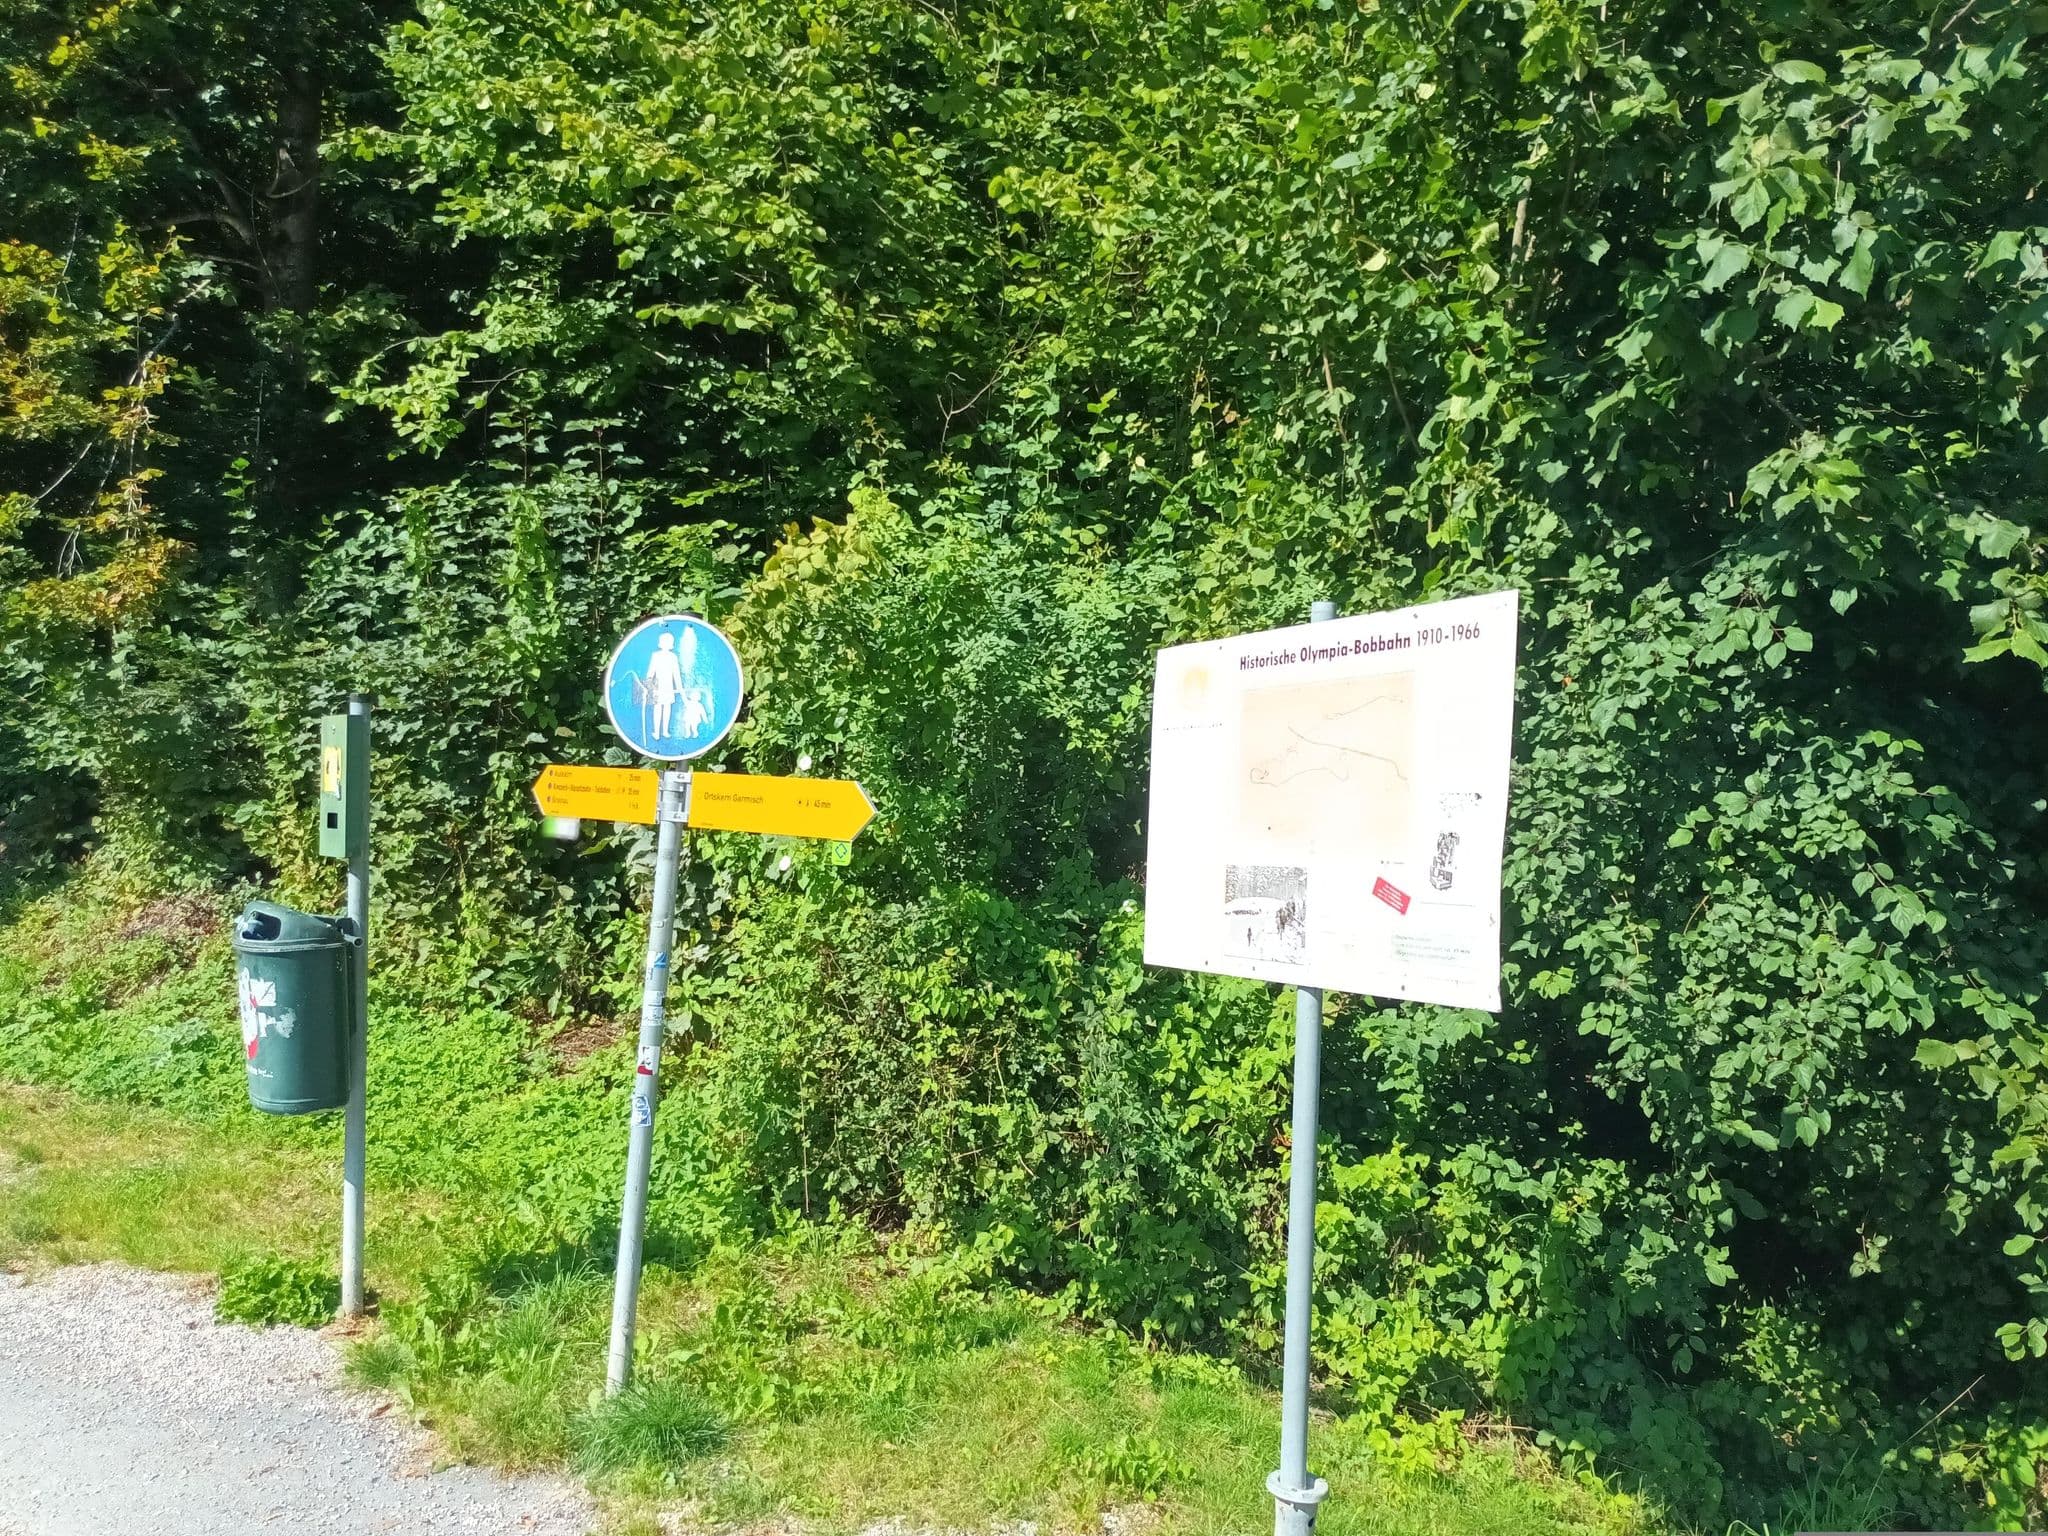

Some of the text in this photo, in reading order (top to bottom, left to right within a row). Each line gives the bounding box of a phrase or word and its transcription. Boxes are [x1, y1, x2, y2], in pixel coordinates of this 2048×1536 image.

[1240, 621, 1480, 671] Historische Olympia-Bobbahn 1910-1966
[733, 794, 763, 805] Garmisch
